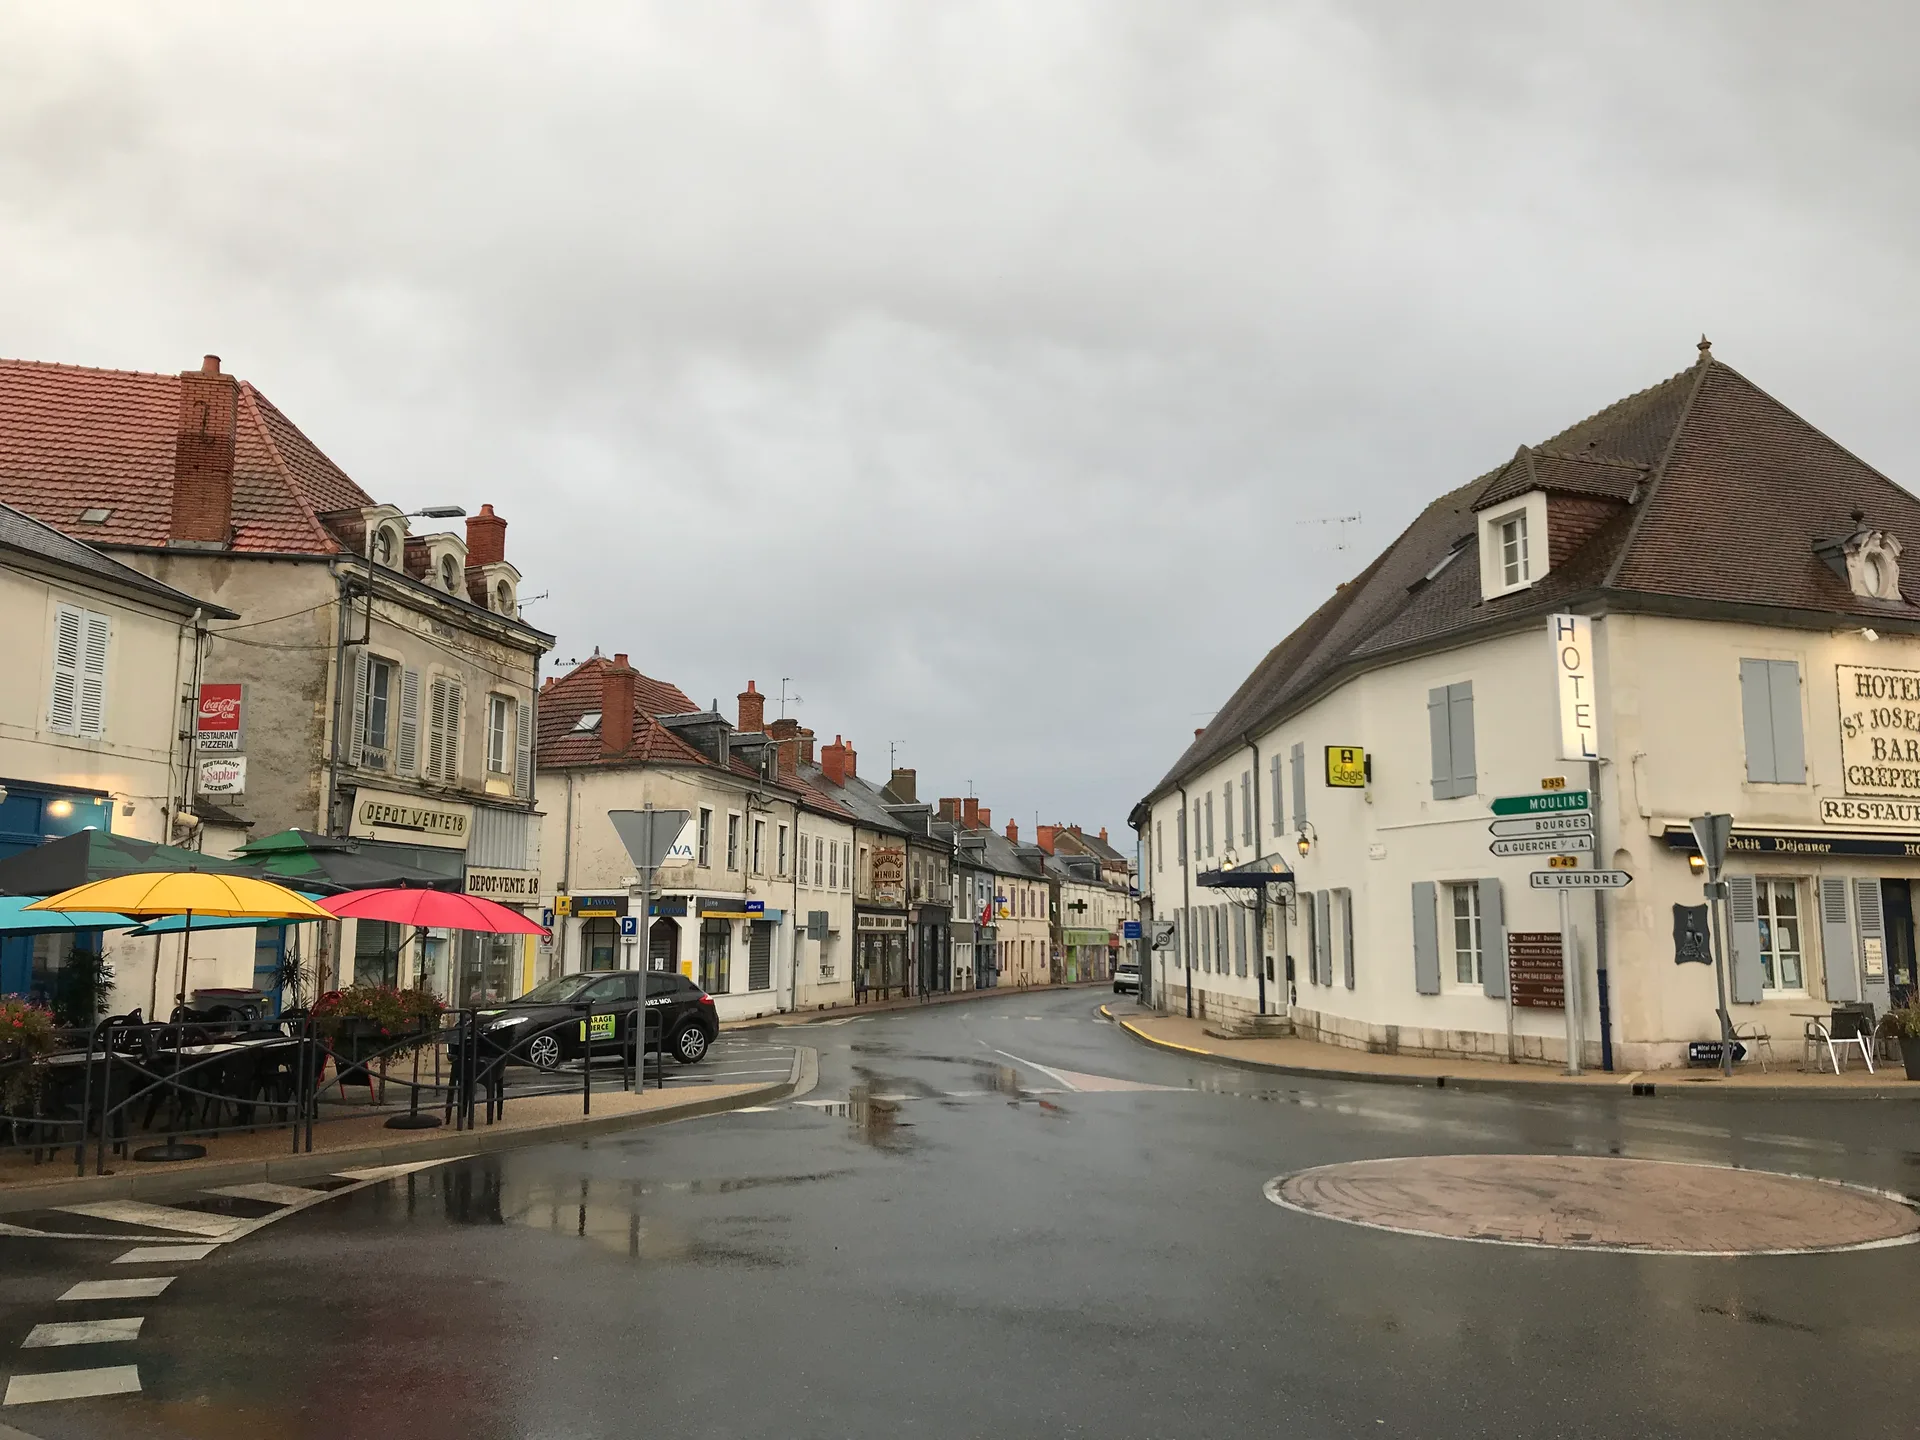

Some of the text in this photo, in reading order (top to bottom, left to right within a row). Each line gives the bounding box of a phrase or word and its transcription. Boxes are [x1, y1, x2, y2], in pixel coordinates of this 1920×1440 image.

[1557, 617, 1597, 758] HOTEL
[198, 731, 237, 740] RESTAURANT
[201, 740, 234, 749] PIZZERIA
[1871, 737, 1920, 763] BAR
[203, 760, 240, 769] RESTAURANT
[1332, 764, 1363, 784] Logis
[204, 783, 233, 791] PIZZERIA
[1530, 795, 1584, 809] MOULINS
[1535, 818, 1586, 830] BOURGES
[1498, 844, 1509, 852] LA
[1513, 841, 1557, 851] GUERCHE
[1726, 836, 1761, 850] Petit
[875, 870, 901, 878] MINOIS
[469, 874, 538, 895] DEPOT-VENTE 18
[1535, 875, 1618, 885] LE VEURDRE
[592, 898, 617, 906] AVIVA
[625, 921, 633, 933] P
[1158, 935, 1168, 943] 30
